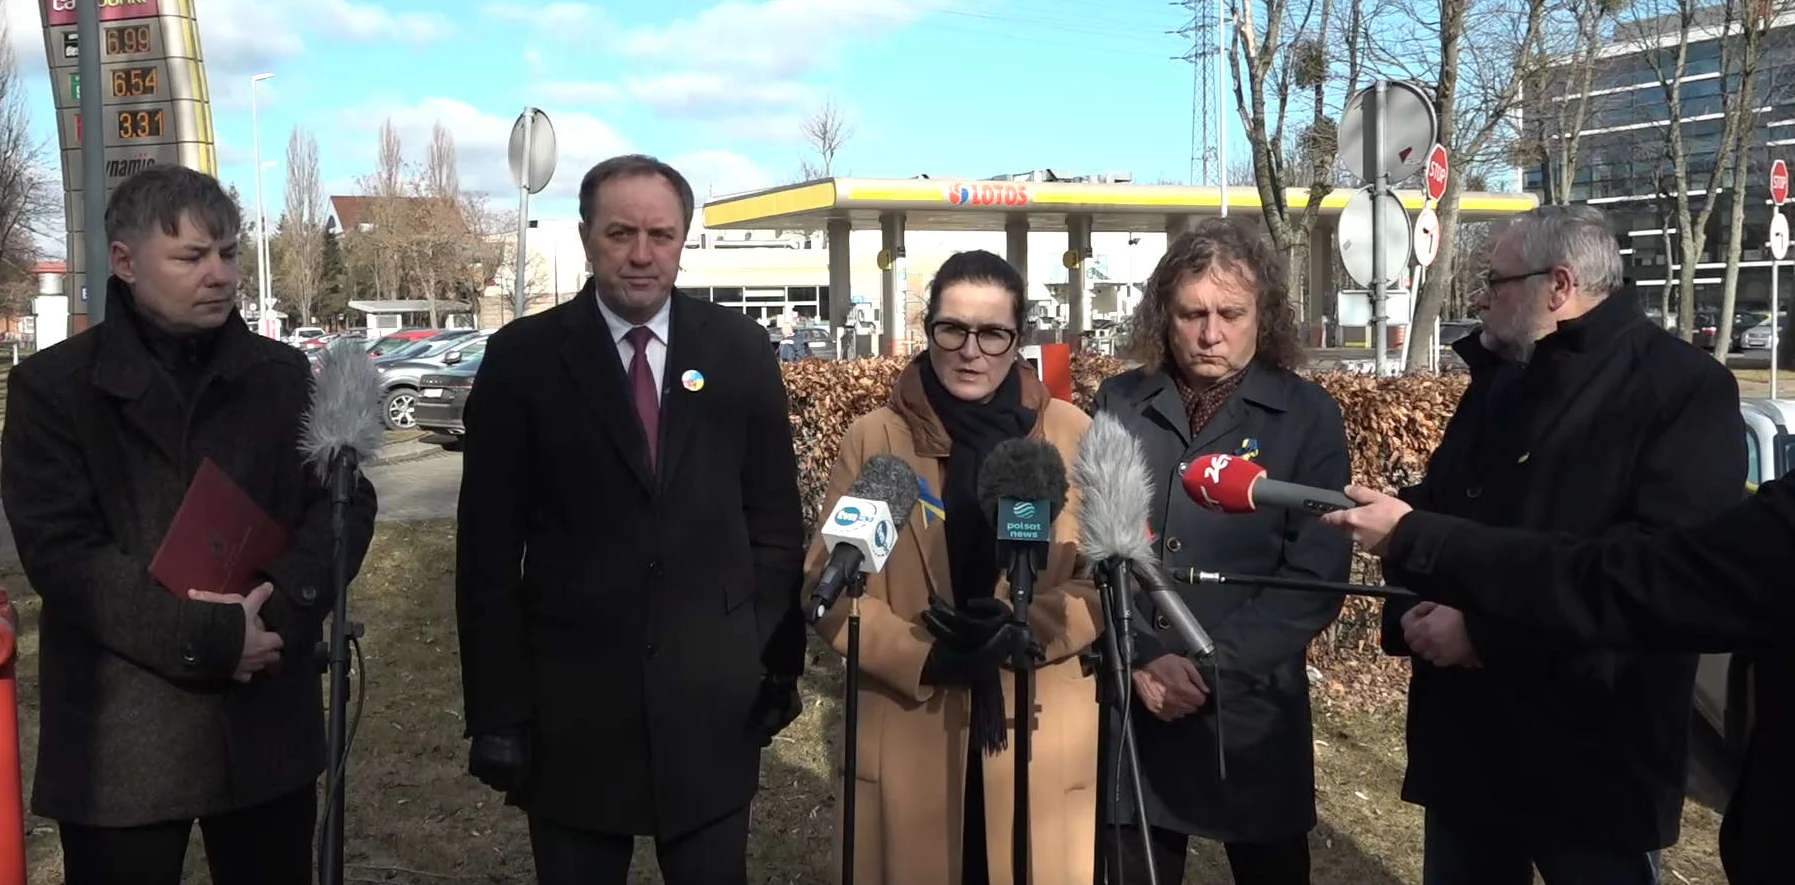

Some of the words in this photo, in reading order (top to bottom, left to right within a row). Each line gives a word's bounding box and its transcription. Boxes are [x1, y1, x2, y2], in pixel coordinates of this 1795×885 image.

[107, 26, 151, 55] 6.99
[114, 68, 158, 97] 6.54
[119, 111, 165, 138] 3.31
[1430, 161, 1446, 183] STOP
[971, 183, 1029, 206] LOTOS
[1007, 521, 1041, 532] polsat
